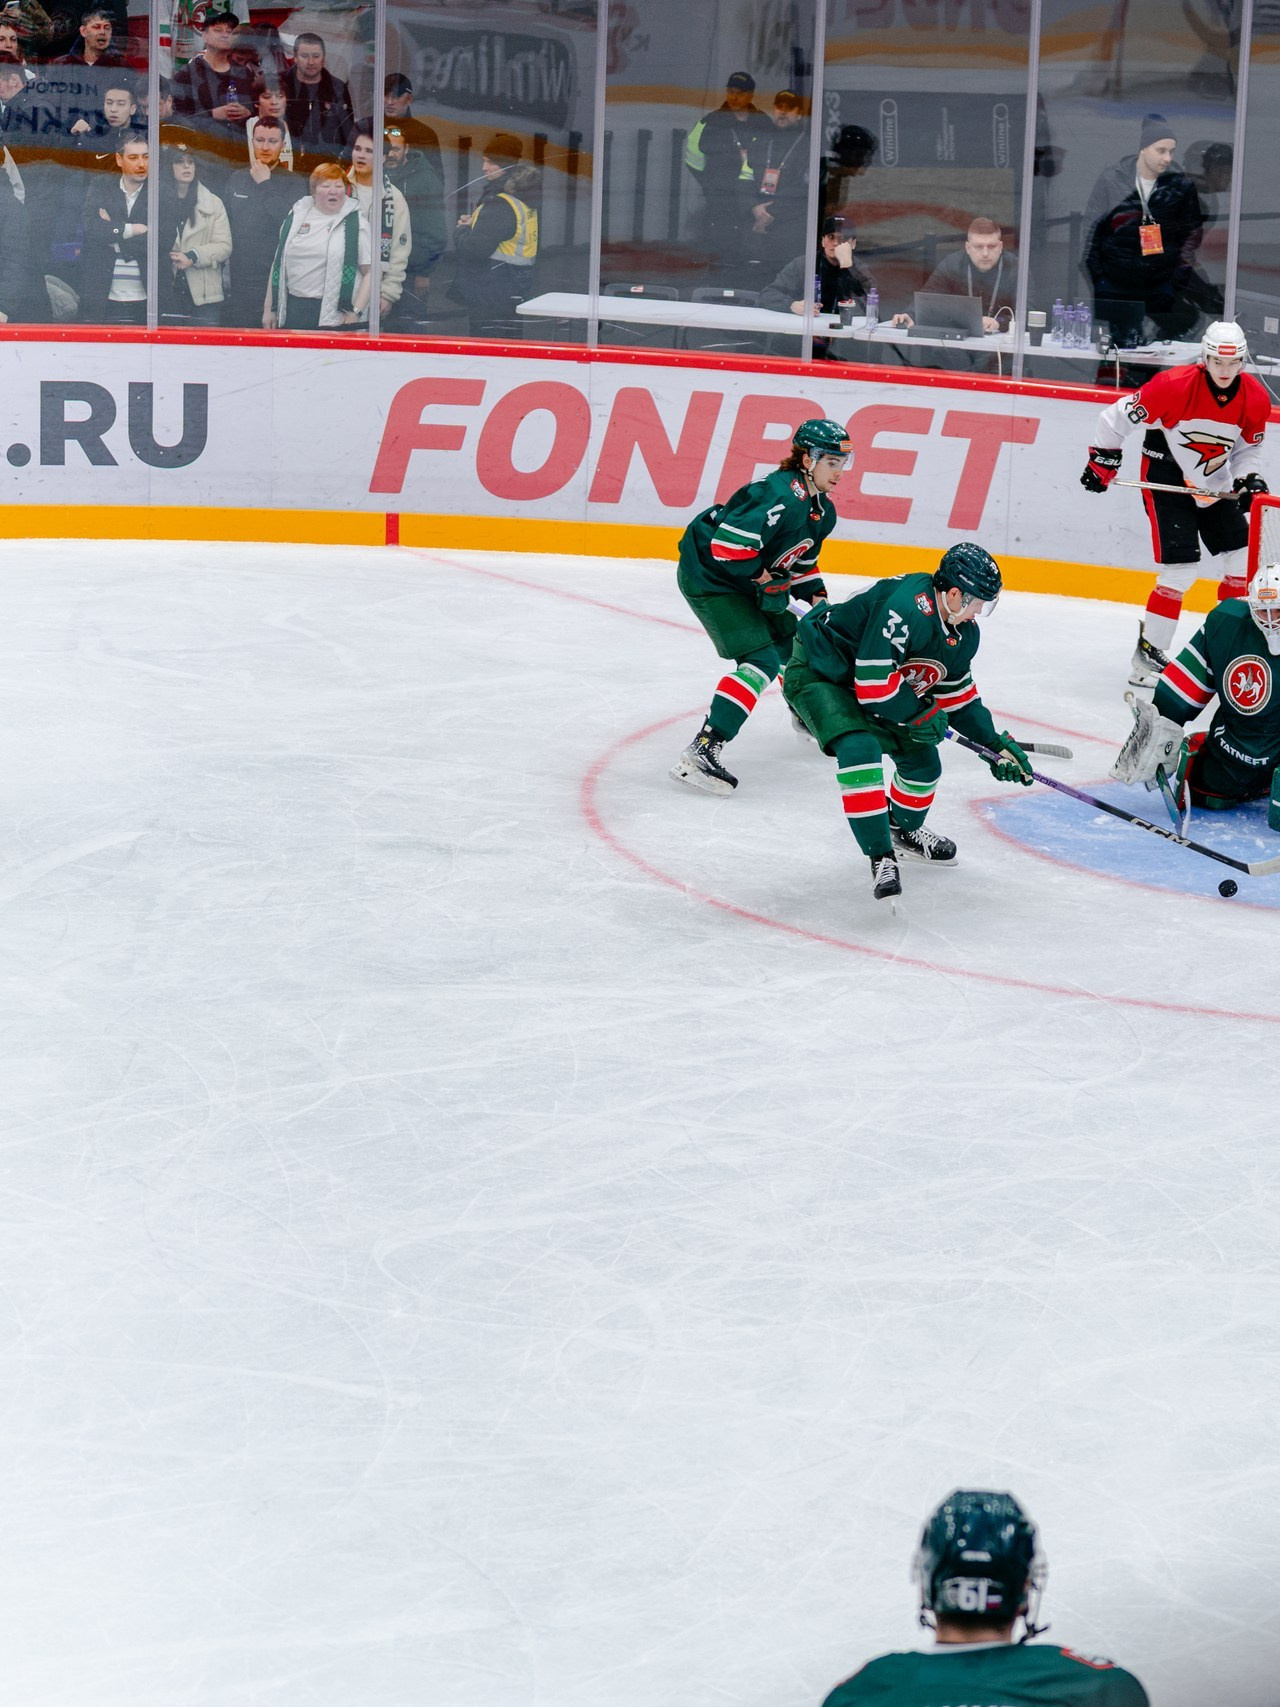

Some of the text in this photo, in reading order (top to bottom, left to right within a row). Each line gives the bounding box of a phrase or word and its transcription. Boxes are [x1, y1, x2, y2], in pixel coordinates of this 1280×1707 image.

[884, 116, 895, 162] Winline
[997, 121, 1007, 165] Winline
[6, 380, 209, 468] .RU
[1124, 391, 1149, 425] 28
[368, 376, 1042, 531] FONBET
[766, 503, 786, 528] 4
[882, 609, 910, 654] 32
[1220, 737, 1270, 766] TATNEFT
[1130, 817, 1192, 848] CCM
[958, 1580, 989, 1613] 61
